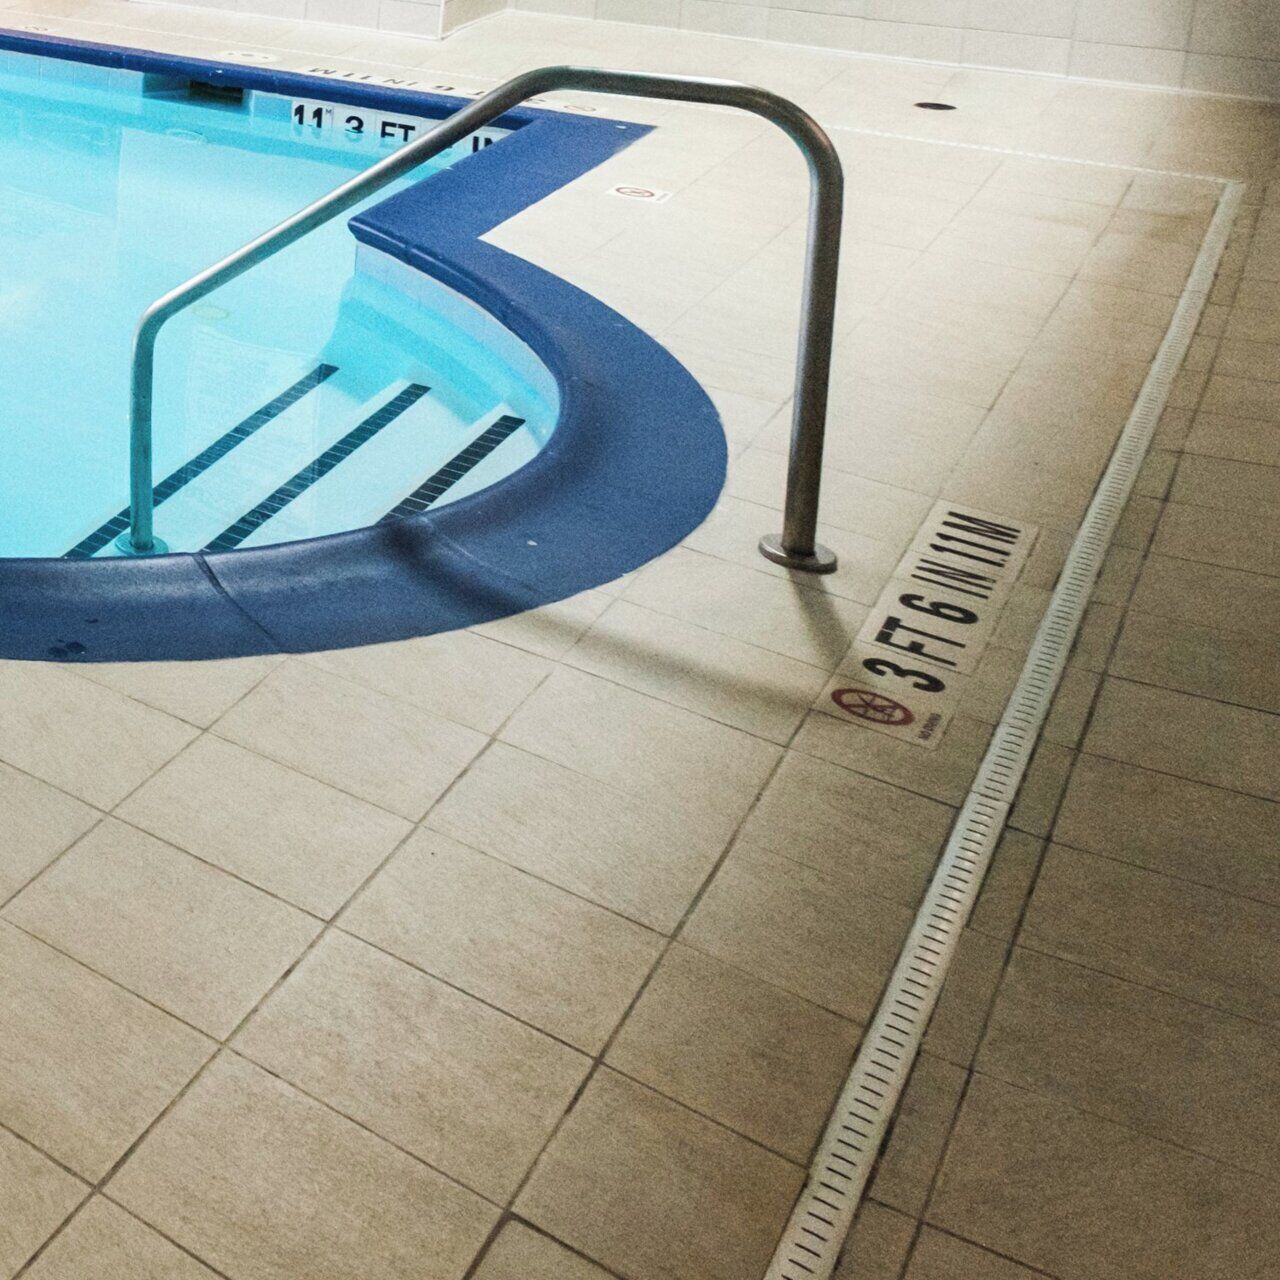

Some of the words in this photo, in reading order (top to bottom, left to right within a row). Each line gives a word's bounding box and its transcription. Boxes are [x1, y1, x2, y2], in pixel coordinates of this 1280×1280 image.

[381, 121, 416, 142] FT
[911, 558, 997, 600] IN
[899, 593, 979, 624] 6
[875, 616, 966, 667] FT
[862, 657, 946, 693] 3
